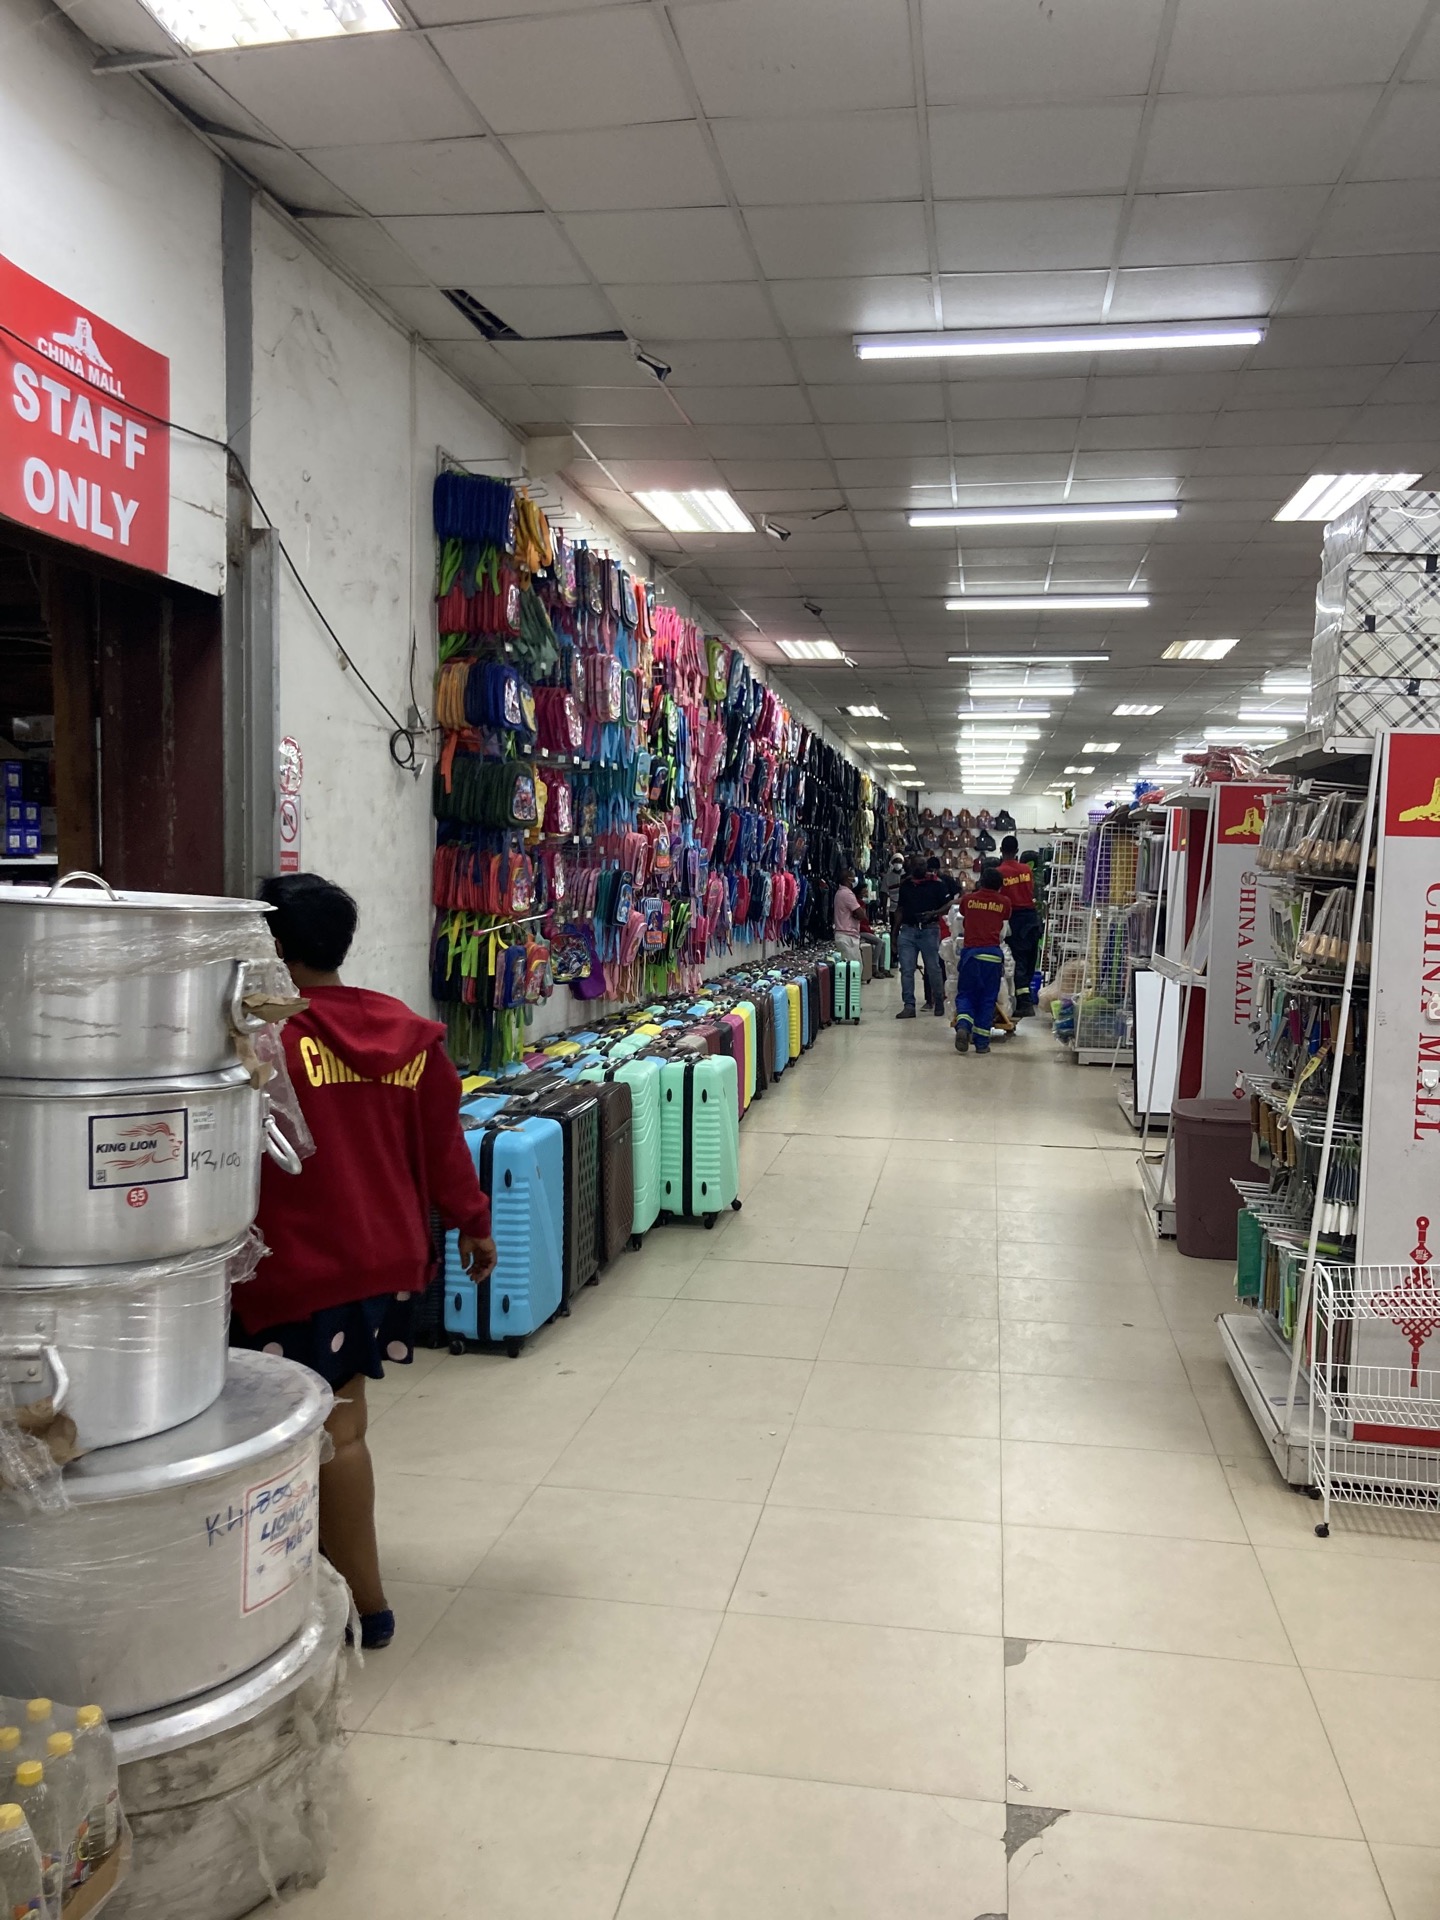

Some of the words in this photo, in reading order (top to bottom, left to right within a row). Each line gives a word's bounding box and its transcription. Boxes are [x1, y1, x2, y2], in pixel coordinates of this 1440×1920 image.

[38, 337, 85, 378] CHINA
[88, 365, 125, 400] MALL
[13, 362, 147, 470] STAFF
[23, 456, 140, 547] ONLY
[1002, 875, 1020, 886] China
[967, 900, 988, 910] China
[988, 901, 1004, 913] Mall
[1237, 871, 1258, 949] CHINA
[1234, 960, 1253, 1025] MALL
[95, 1143, 127, 1154] KING
[129, 1140, 158, 1152] LION
[191, 1149, 241, 1171] K2,100
[130, 1189, 146, 1202] 55
